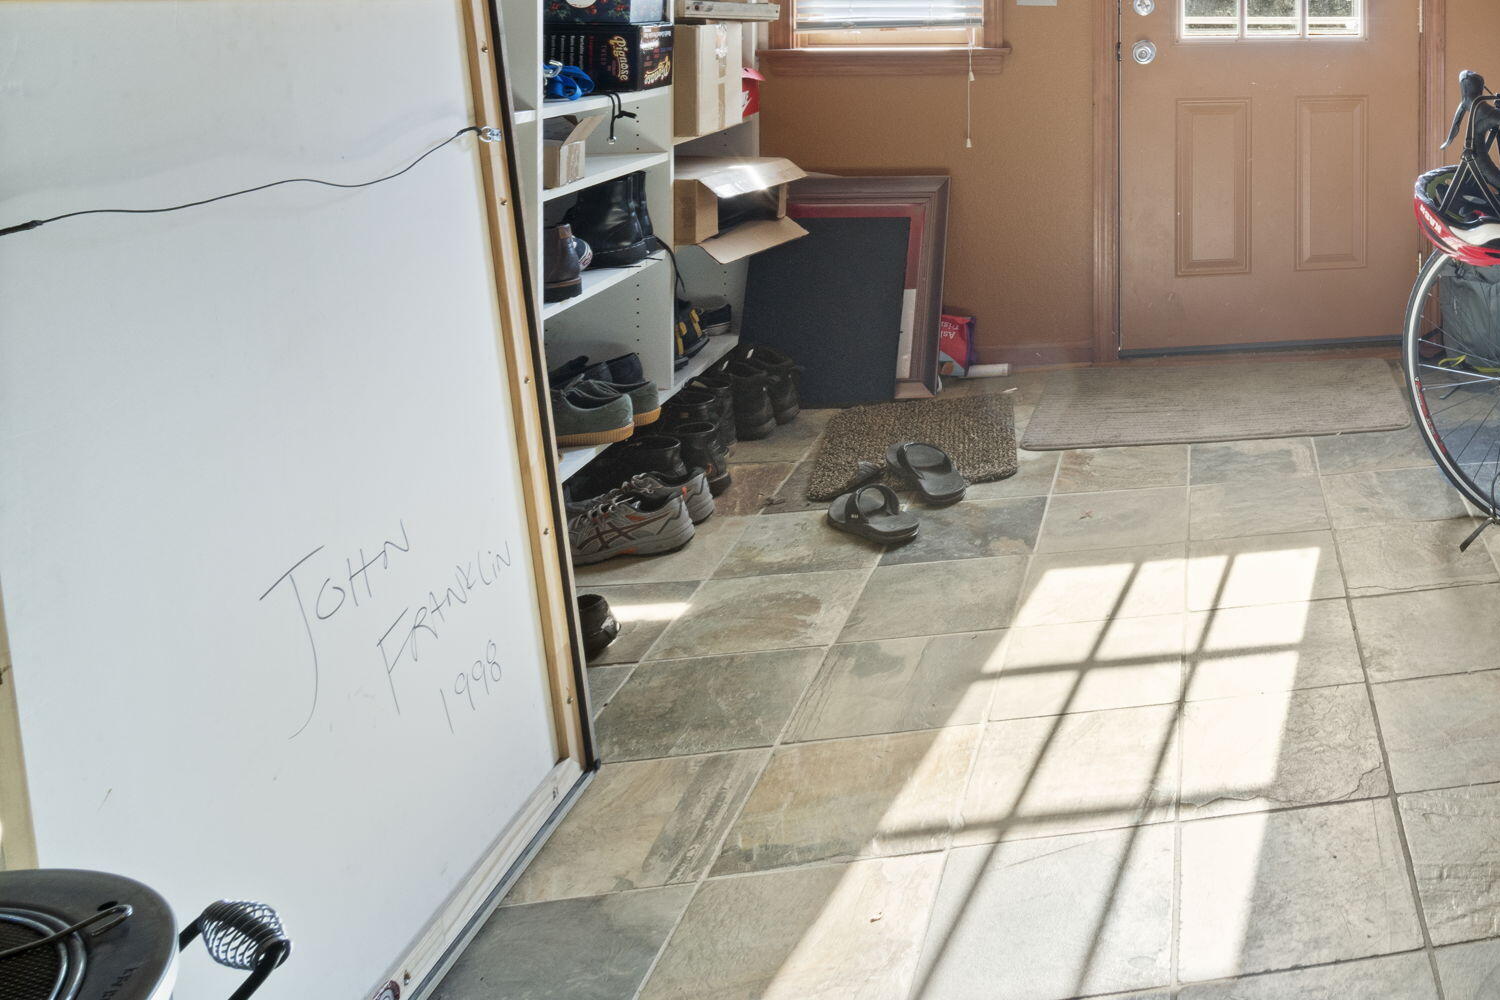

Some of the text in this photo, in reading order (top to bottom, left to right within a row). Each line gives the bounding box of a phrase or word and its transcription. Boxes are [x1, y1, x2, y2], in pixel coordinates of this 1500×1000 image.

[608, 35, 629, 81] Pignose
[259, 519, 410, 740] JOHN
[439, 639, 502, 735] 1998
